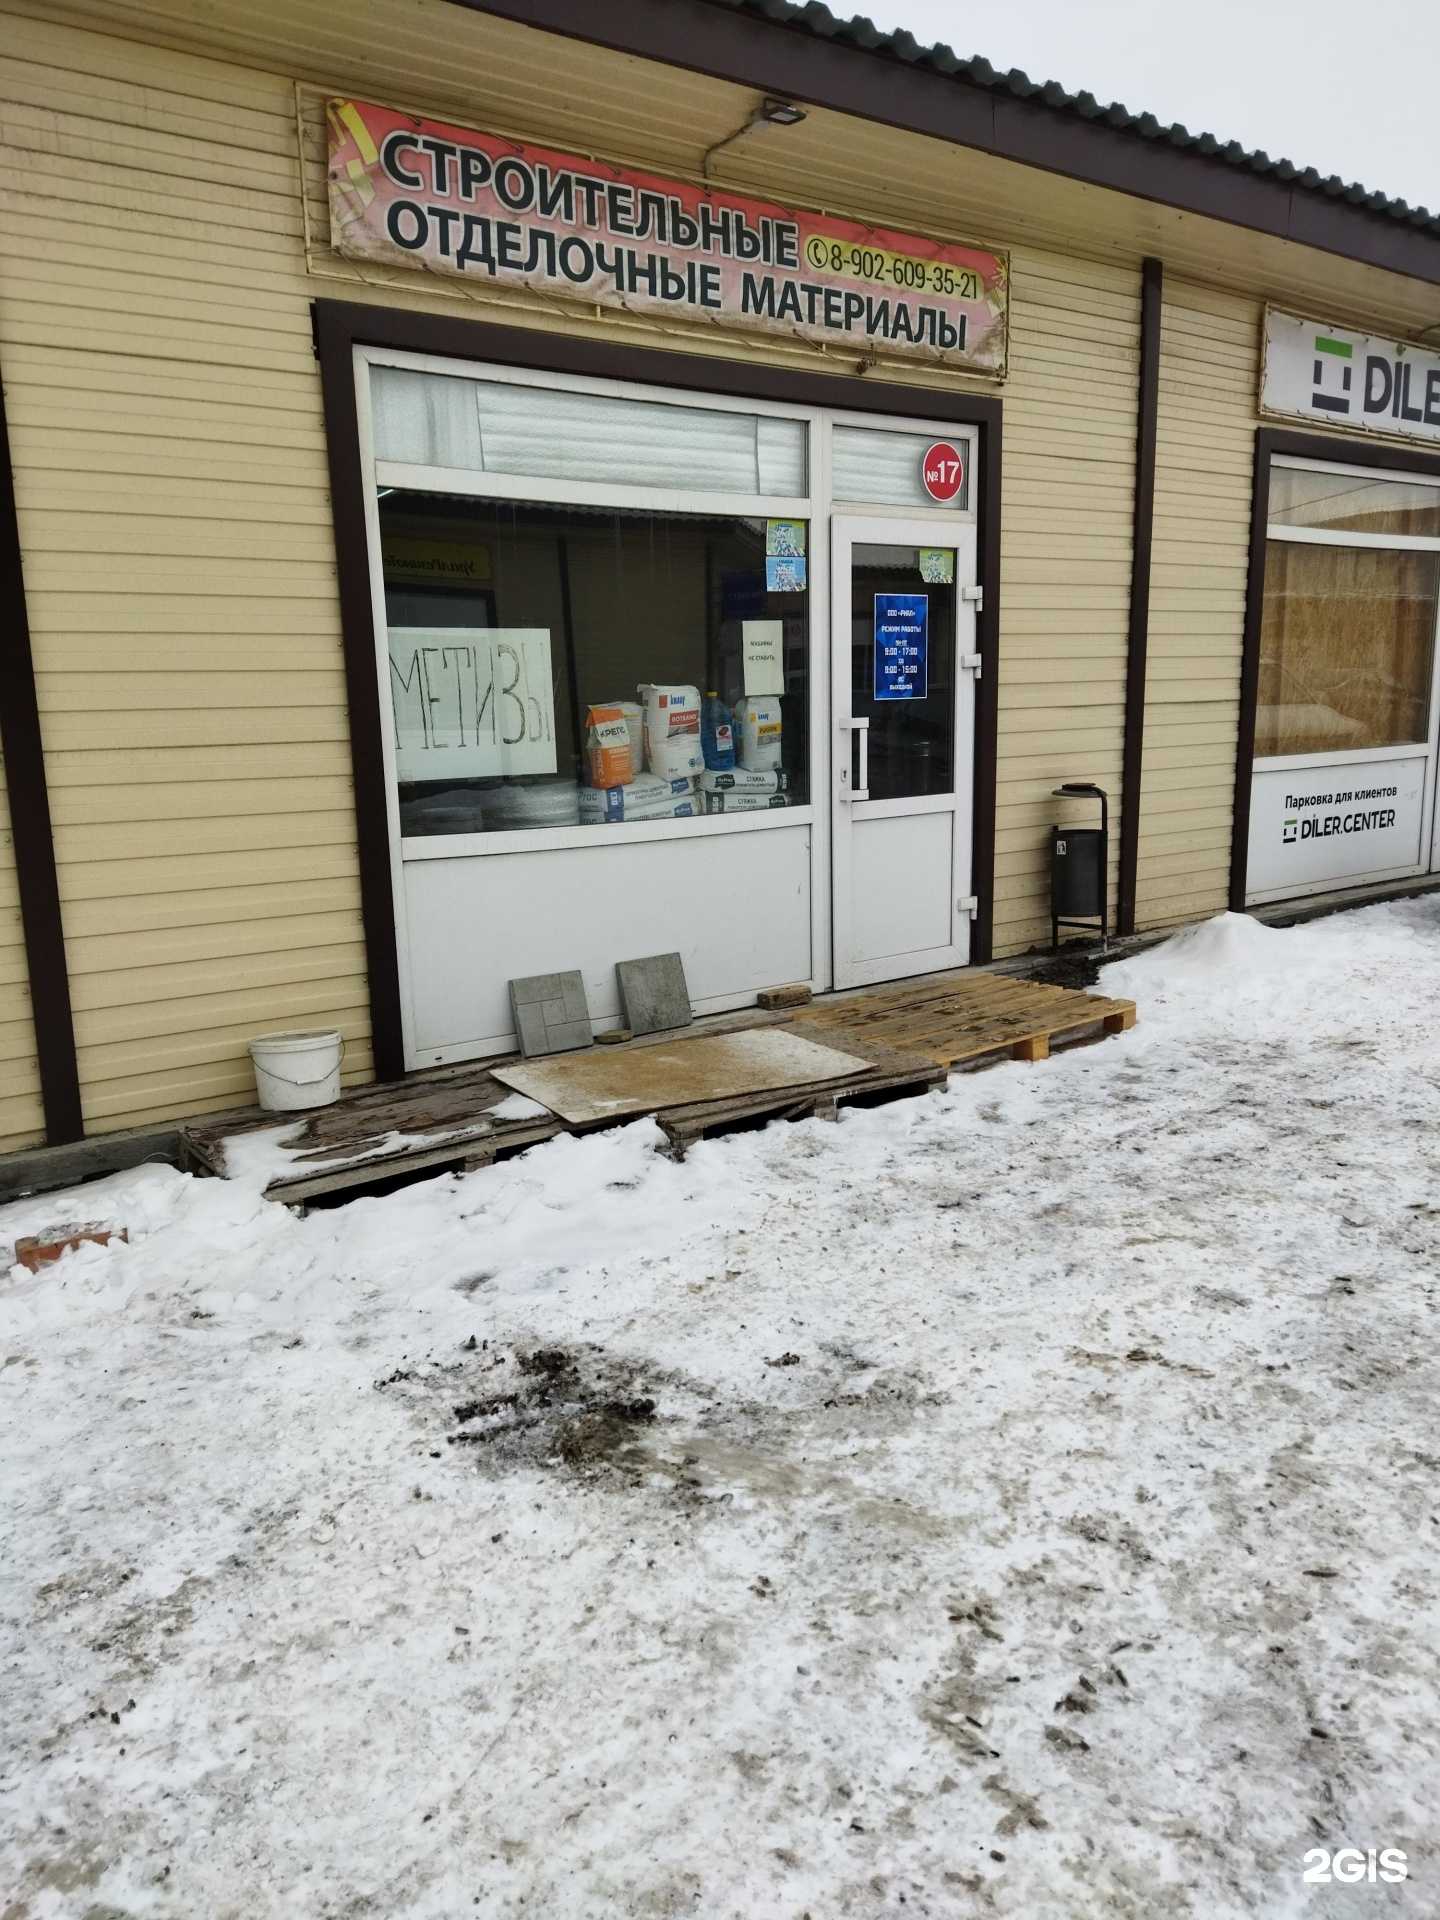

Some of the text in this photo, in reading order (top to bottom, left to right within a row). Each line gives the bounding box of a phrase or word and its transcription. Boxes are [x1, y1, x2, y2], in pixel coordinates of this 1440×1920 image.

[382, 133, 799, 268] СТРОИТЕЛЬНЫЕ
[387, 200, 967, 351] ОТДЕЛОЧНЫЕ МАТЕРИАЛЫ
[830, 243, 978, 300] 8-902-609-35-21
[881, 625, 922, 633] РЕЖИМ РАБОТЫ
[389, 642, 551, 750] МЕТИЗЫ
[1285, 786, 1397, 811] Парковка для клиентов
